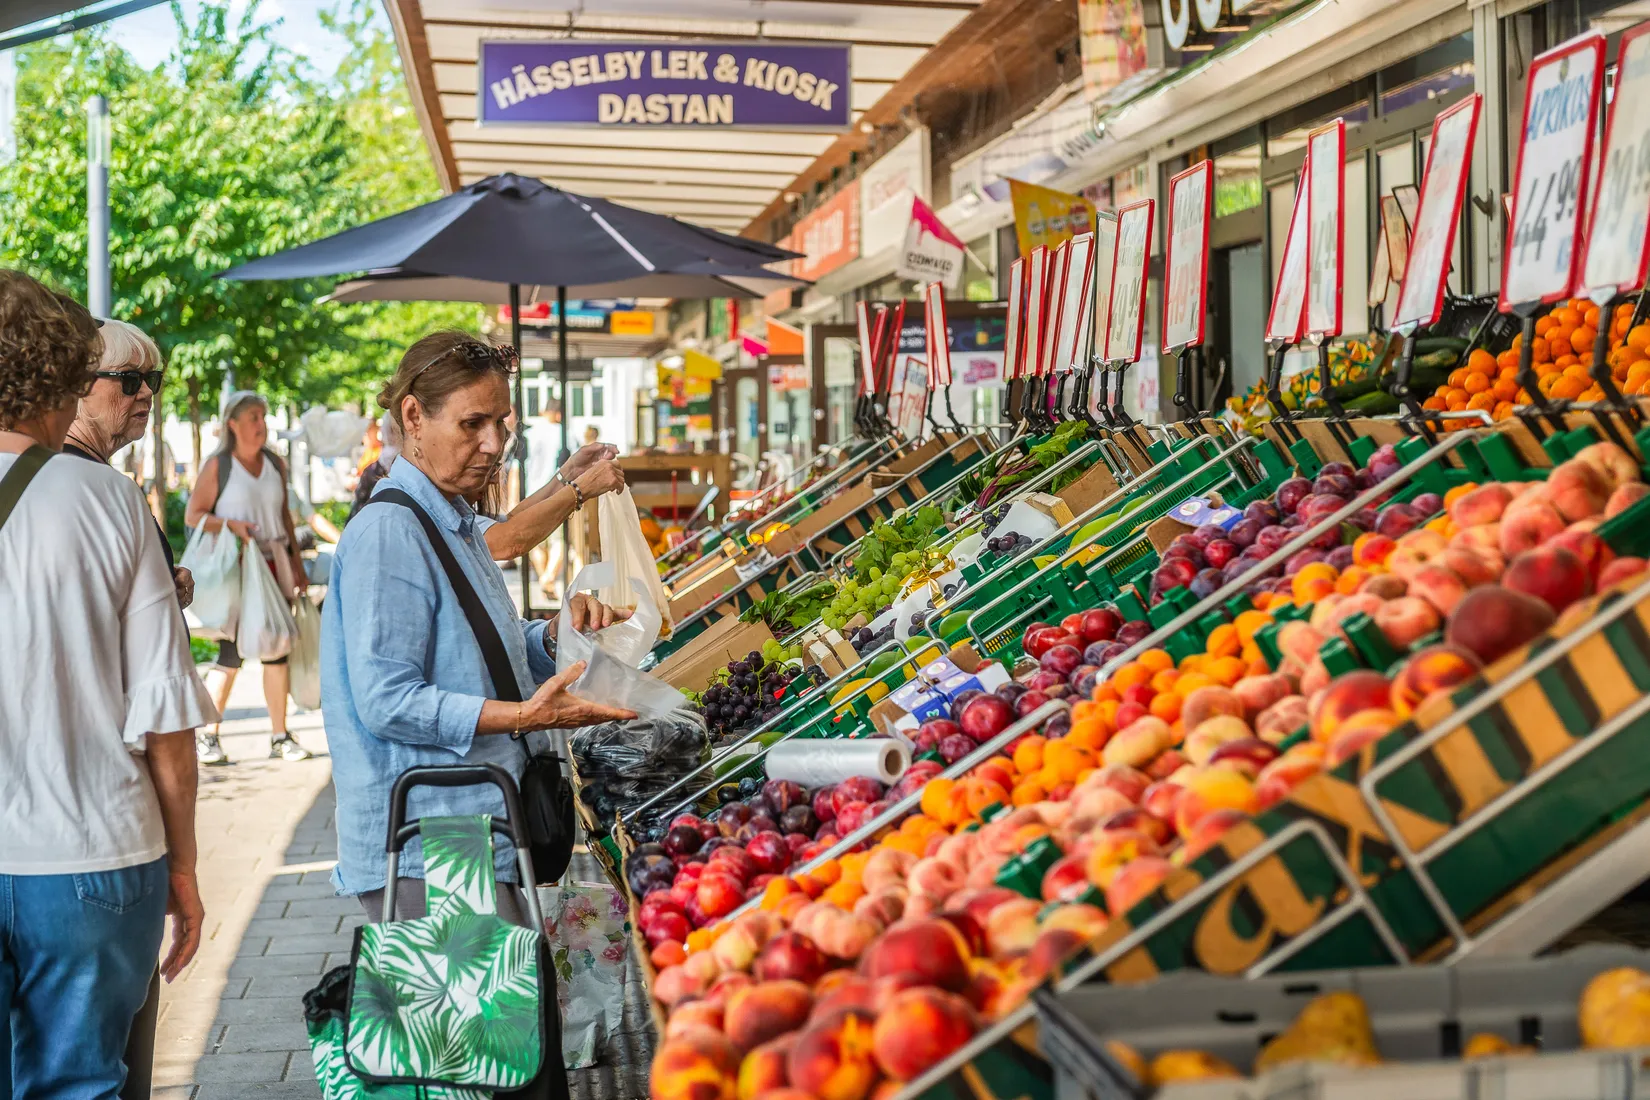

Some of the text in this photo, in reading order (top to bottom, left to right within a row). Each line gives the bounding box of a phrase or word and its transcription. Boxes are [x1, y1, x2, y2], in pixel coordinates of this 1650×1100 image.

[490, 50, 839, 111] HÄSSELBY LEK & KIOSK
[598, 94, 734, 124] DASTAN
